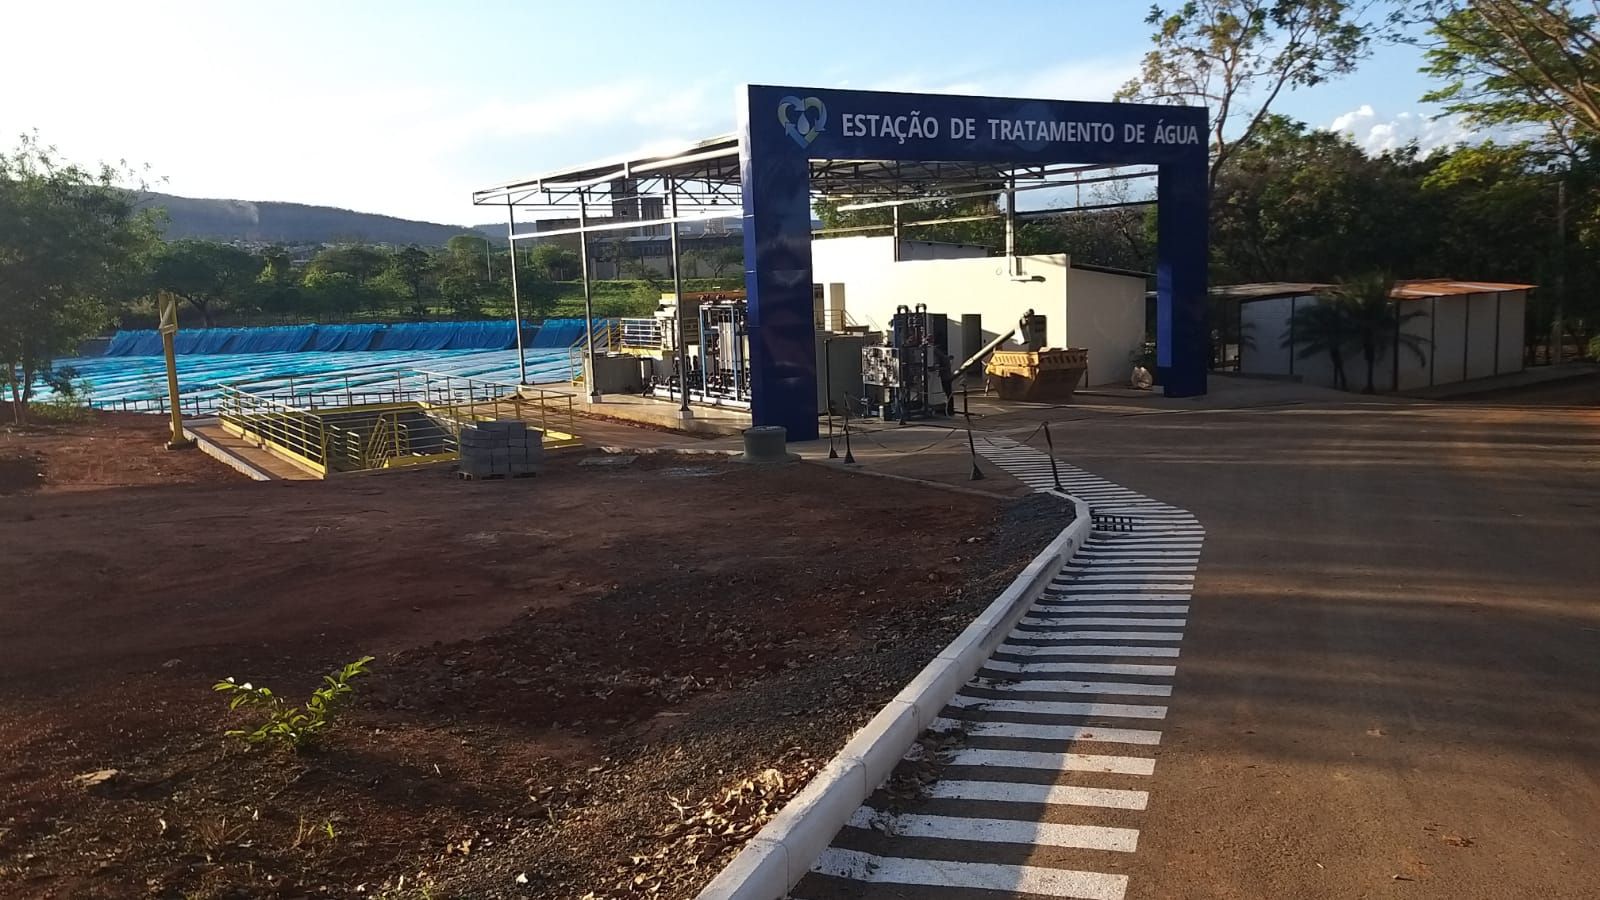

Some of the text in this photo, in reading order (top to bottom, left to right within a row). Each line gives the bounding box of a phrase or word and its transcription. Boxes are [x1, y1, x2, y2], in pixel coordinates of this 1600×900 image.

[842, 111, 1199, 145] ESTAÇÃO DE TRATAMENTO DE ÁGUA
